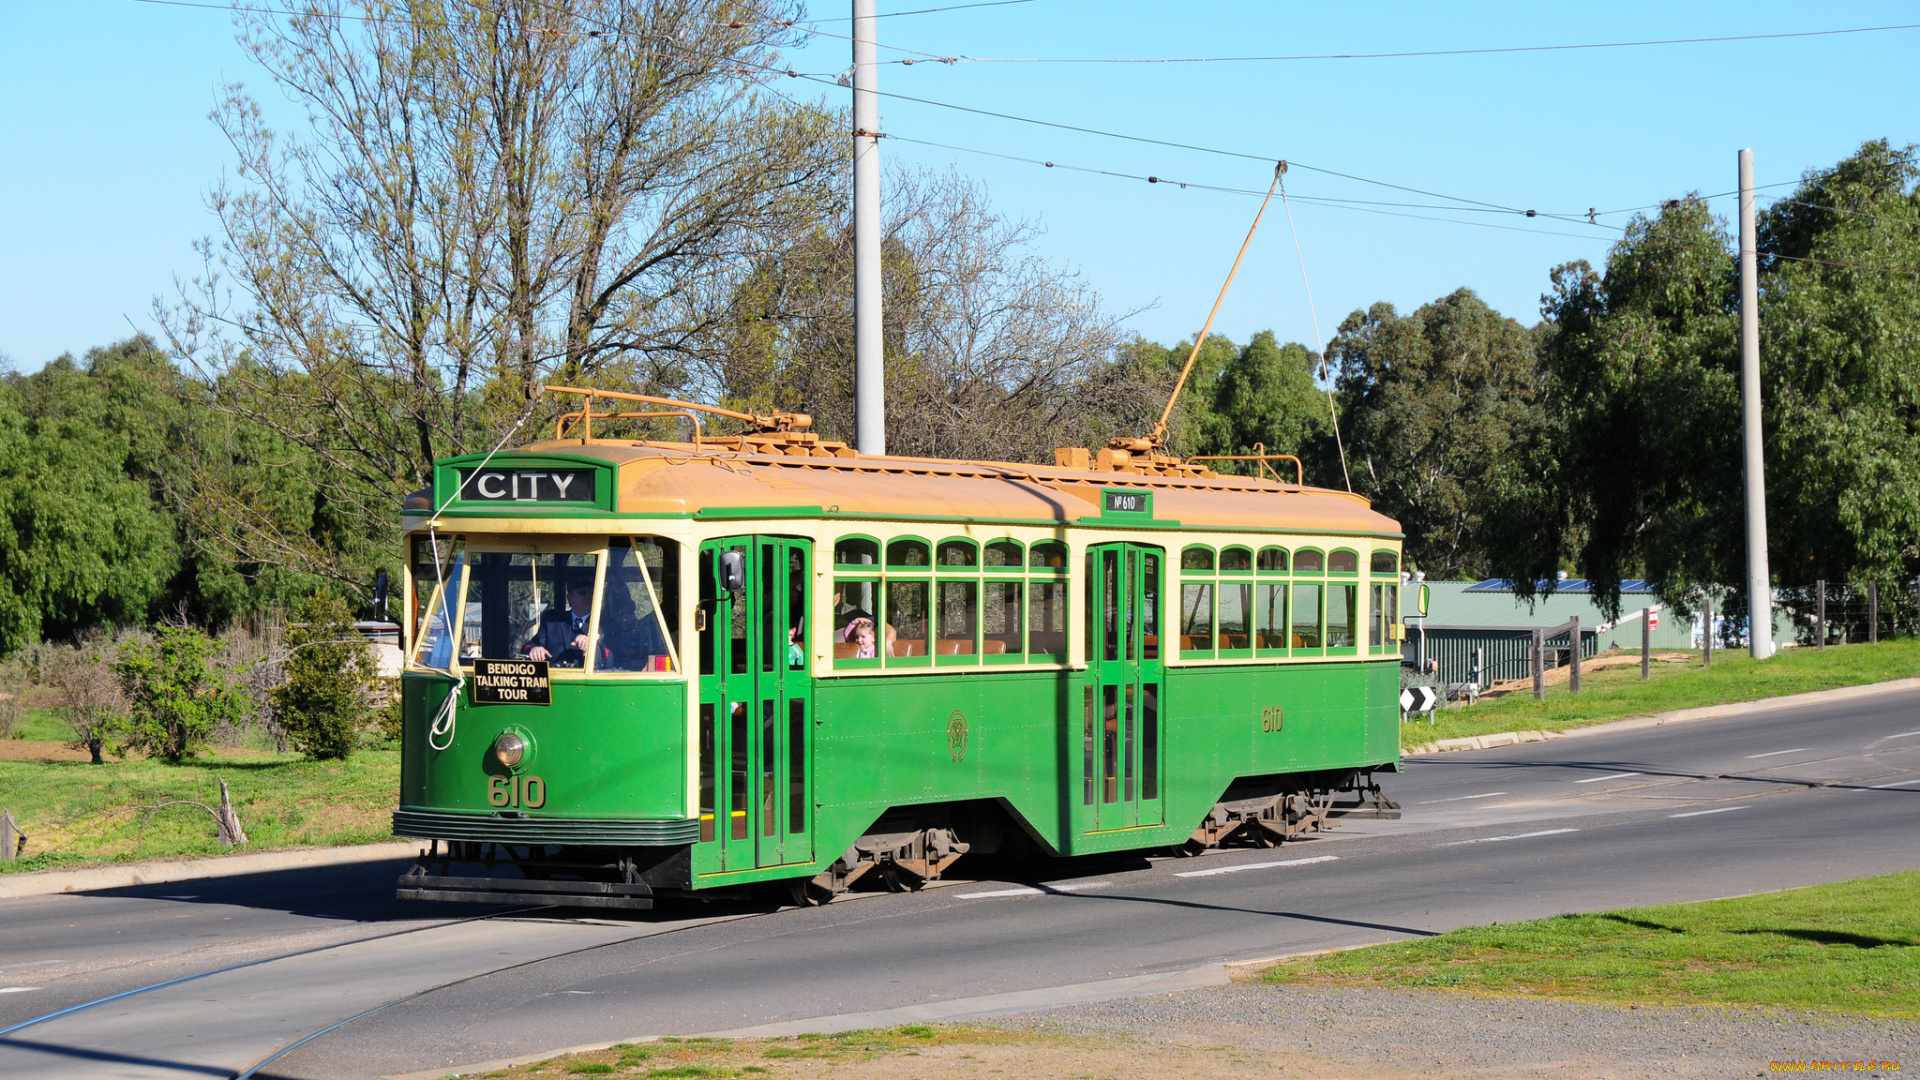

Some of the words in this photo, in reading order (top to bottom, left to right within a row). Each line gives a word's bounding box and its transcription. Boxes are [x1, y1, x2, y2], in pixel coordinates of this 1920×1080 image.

[477, 472, 575, 499] CITY
[1122, 496, 1136, 510] 610
[487, 663, 536, 675] BENDIGO
[476, 675, 518, 687] TALKING
[519, 676, 548, 688] TRAM
[497, 688, 528, 700] TOUR
[1262, 705, 1283, 733] 610
[487, 775, 546, 809] 610
